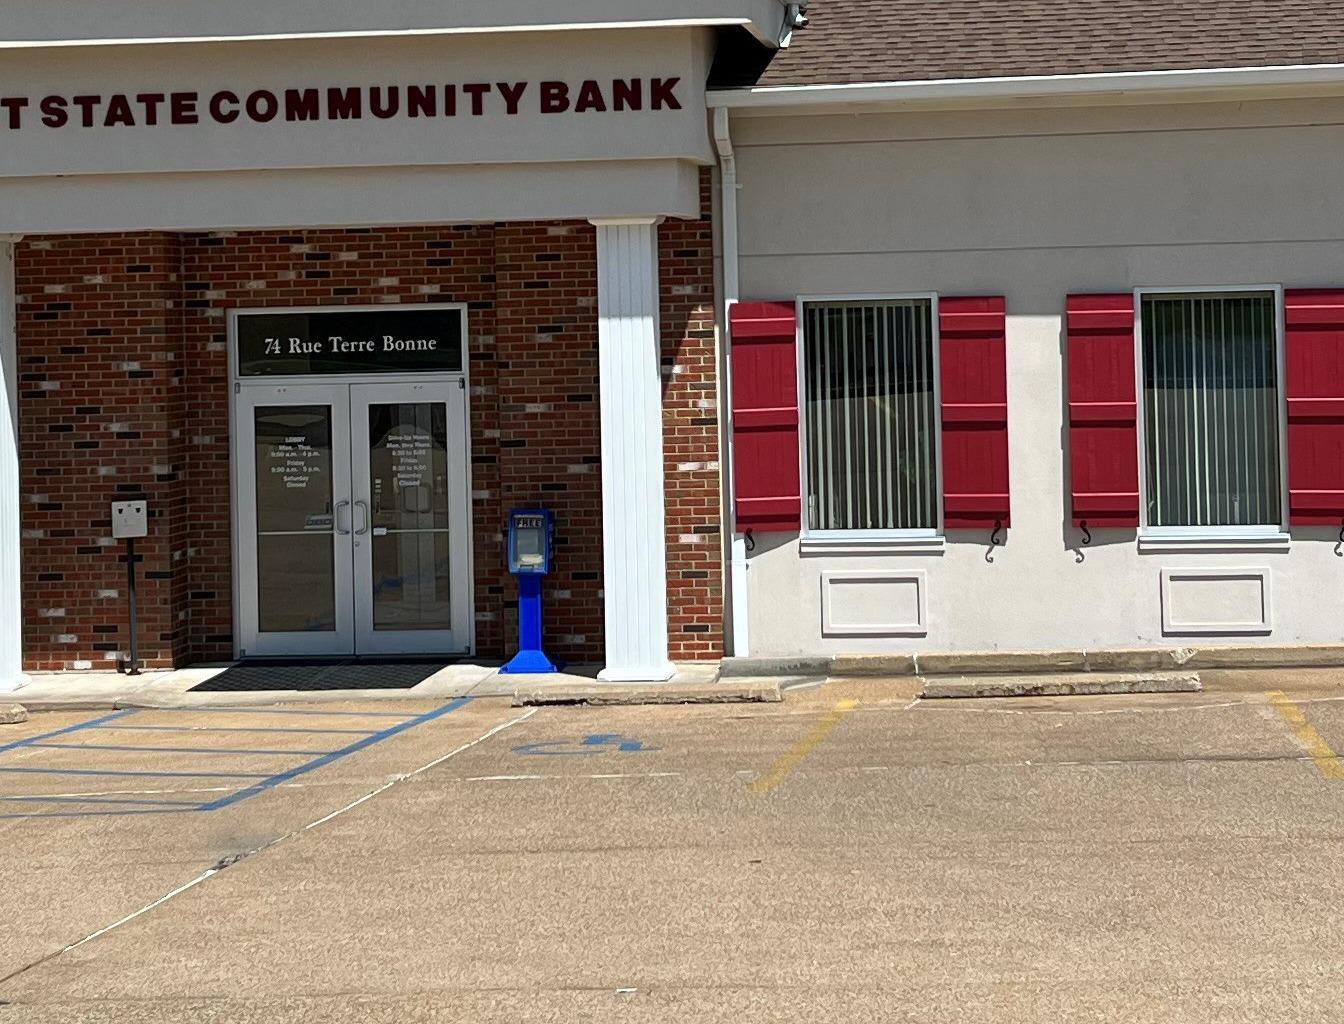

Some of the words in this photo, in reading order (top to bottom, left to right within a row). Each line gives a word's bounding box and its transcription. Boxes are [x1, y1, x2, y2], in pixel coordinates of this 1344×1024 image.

[39, 91, 200, 129] STATE
[209, 81, 530, 124] COMMUNITY
[539, 76, 683, 114] BANK
[264, 338, 282, 354] 74
[288, 337, 323, 354] Rue
[328, 336, 375, 353] Terre
[382, 335, 437, 351] Bonne
